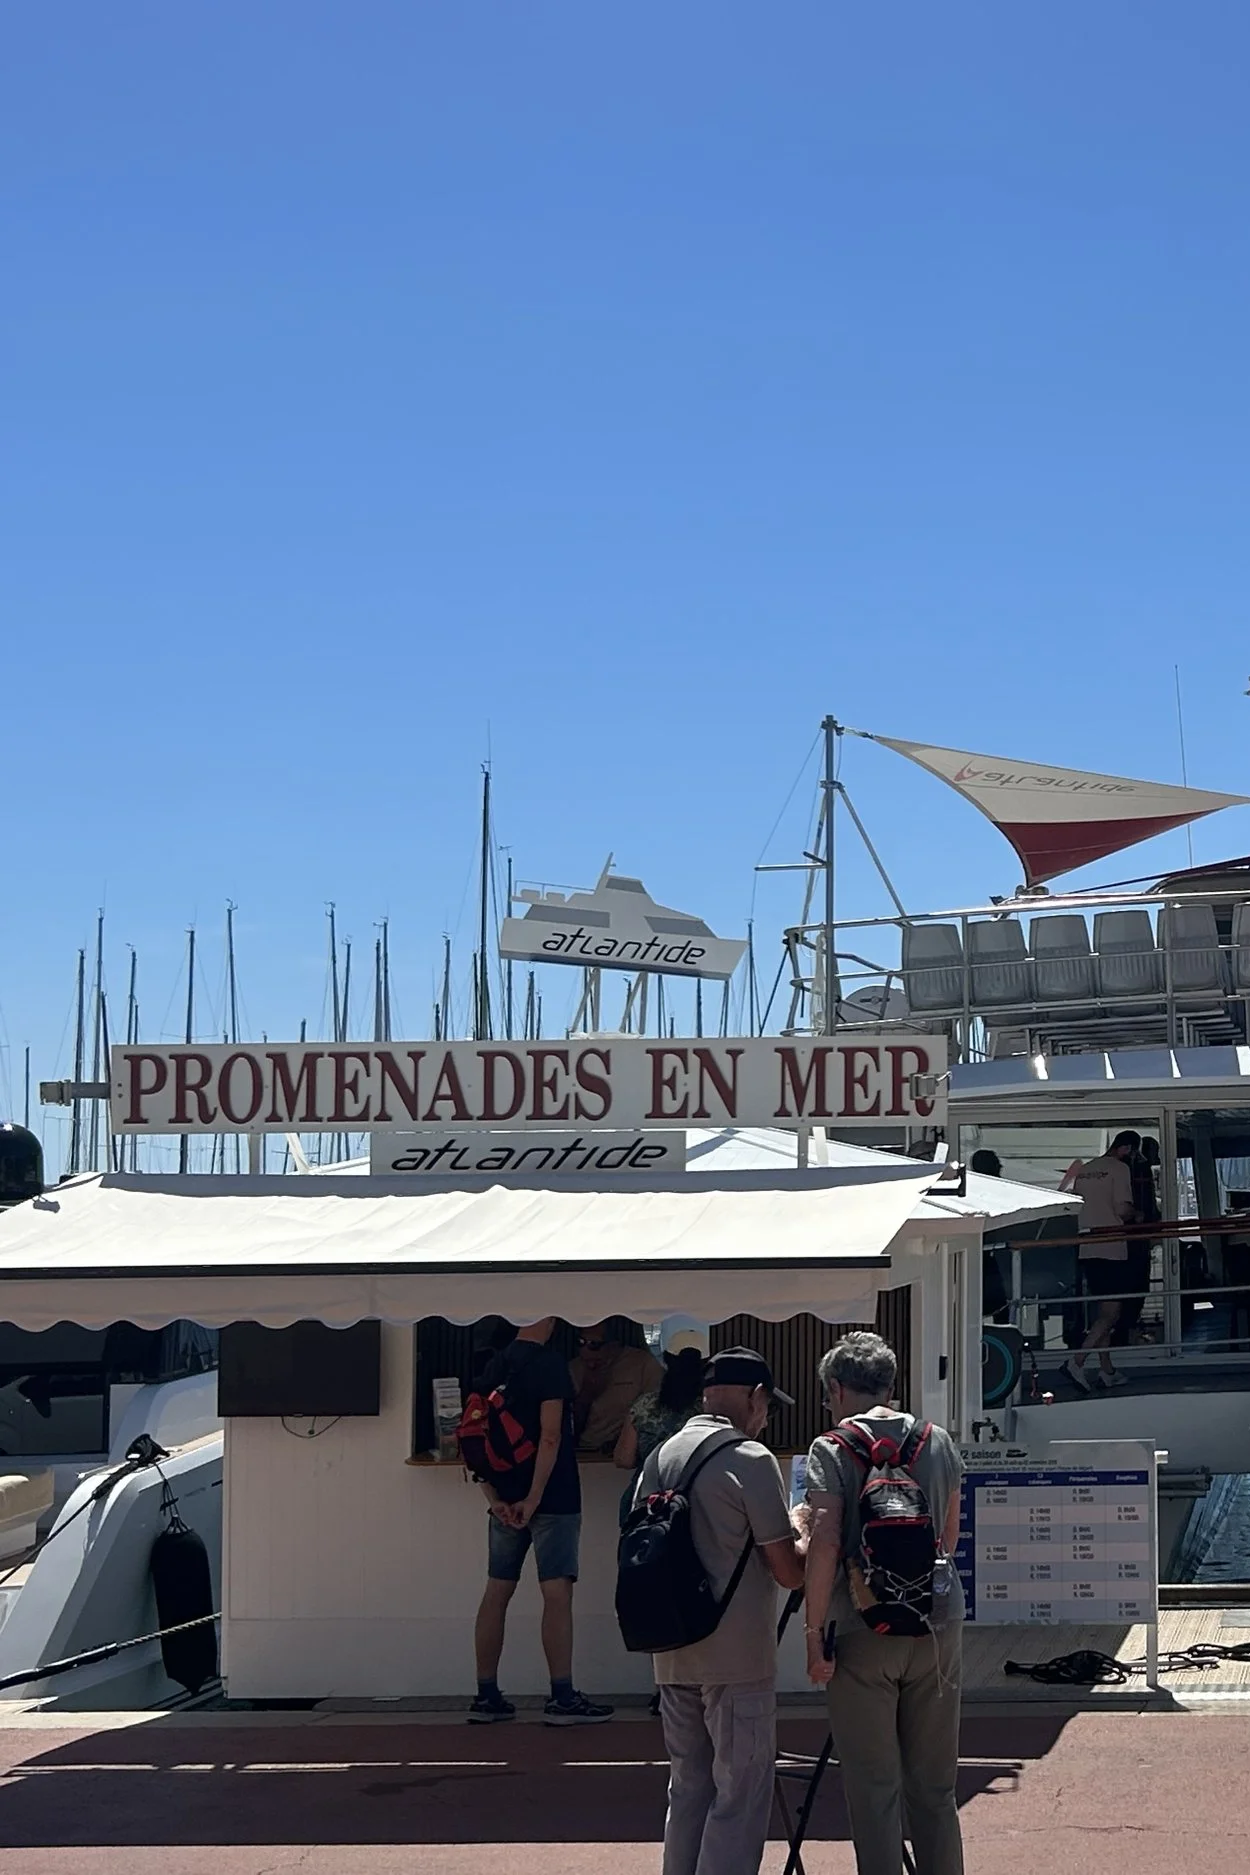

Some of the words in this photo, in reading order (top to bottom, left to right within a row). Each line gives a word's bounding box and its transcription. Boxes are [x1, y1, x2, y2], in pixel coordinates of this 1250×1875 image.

[542, 927, 706, 965] atlantide
[122, 1048, 613, 1125] PROMENADES
[644, 1047, 745, 1119] EN
[773, 1046, 936, 1119] MER
[391, 1137, 668, 1172] atlantide
[971, 1449, 1001, 1459] saison
